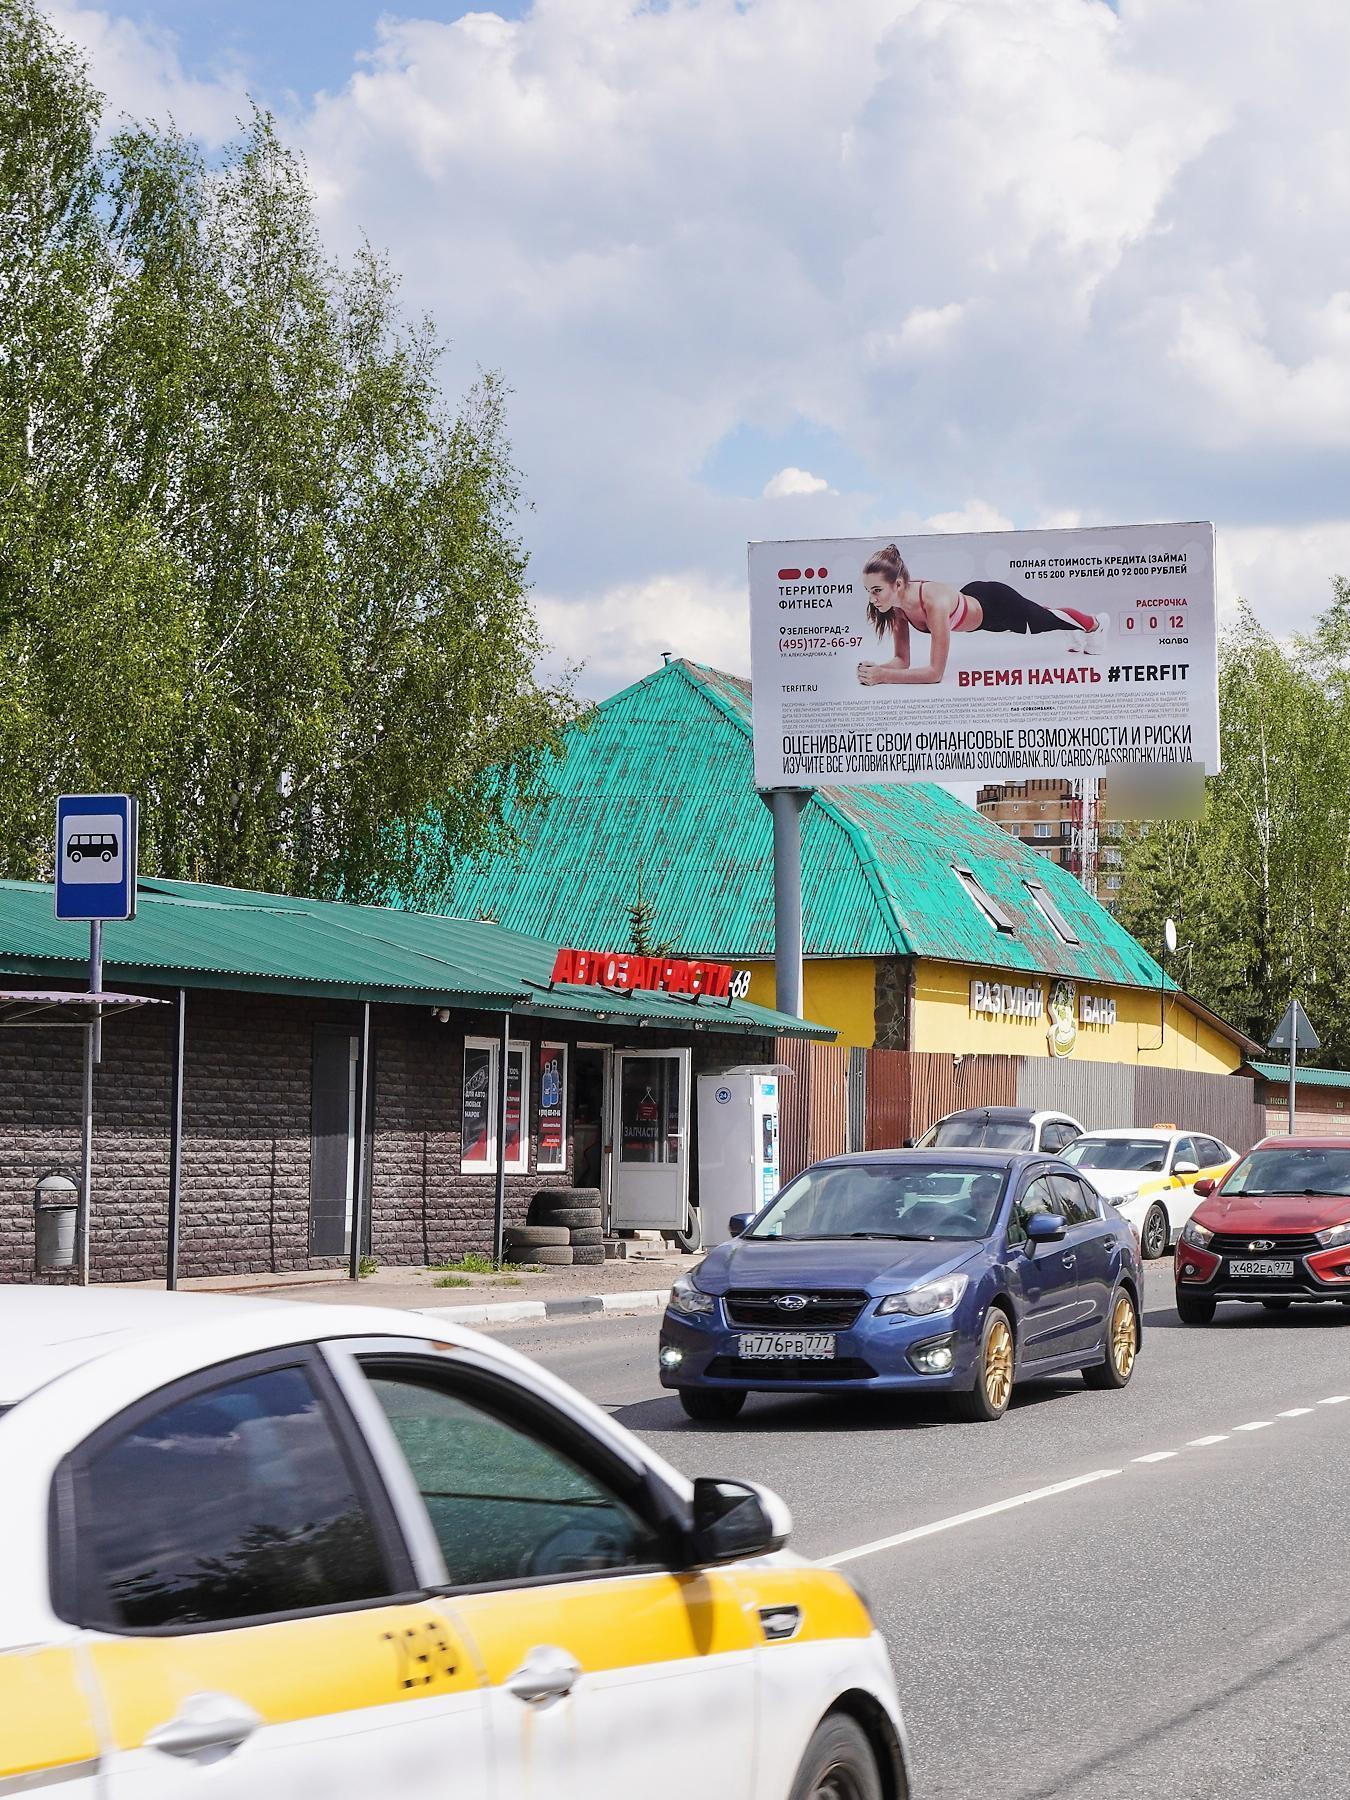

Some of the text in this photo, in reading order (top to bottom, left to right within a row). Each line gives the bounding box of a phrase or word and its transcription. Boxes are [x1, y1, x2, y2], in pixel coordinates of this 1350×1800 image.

[1009, 559, 1046, 568] ПОЛНАЯ
[1048, 557, 1102, 567] СТОИМОСТЬ
[1104, 555, 1147, 565] КРЕДИТА
[1025, 564, 1187, 579] ОТ 55 200 РУБЛЕЙ ДО 92 000 РУБЛЕЙ
[779, 584, 853, 596] ТЕРРИТОРИЯ
[779, 599, 833, 609] ФИТНЕСА
[1136, 598, 1188, 607] РАССРОЧКА
[1126, 615, 1184, 630] 0 0 12
[787, 625, 849, 636] ЗЕЛЕНОГРАД-2
[778, 637, 863, 652] (495)172-66-97
[958, 663, 1190, 687] ВРЕМЯ НАЧАТЬ #TERFIT
[782, 684, 818, 693] TERFIT.RU
[782, 724, 1192, 756] ОЦЕНИВАЙТЕ СВОИ ФИНАНСОВЫЕ ВОЗМОЖНОСТИ И РИСКИ
[783, 755, 824, 774] ИЗУЧИТЕ
[826, 755, 844, 773] ВСЕ
[846, 754, 889, 773] УСЛОВИЯ
[889, 752, 933, 773] КРЕДИТА
[935, 749, 976, 770] (ЗАЙМА)
[551, 948, 732, 998] АВТОЗАПЧАСТИ
[970, 981, 1116, 1025] РАЗГУЛЯЙ БАНЯ
[719, 1092, 728, 1100] 24
[624, 1127, 659, 1138] ЗАПЧАСТИ
[1233, 1261, 1273, 1274] Х482ЕА
[744, 1336, 830, 1353] Н776РВ 777
